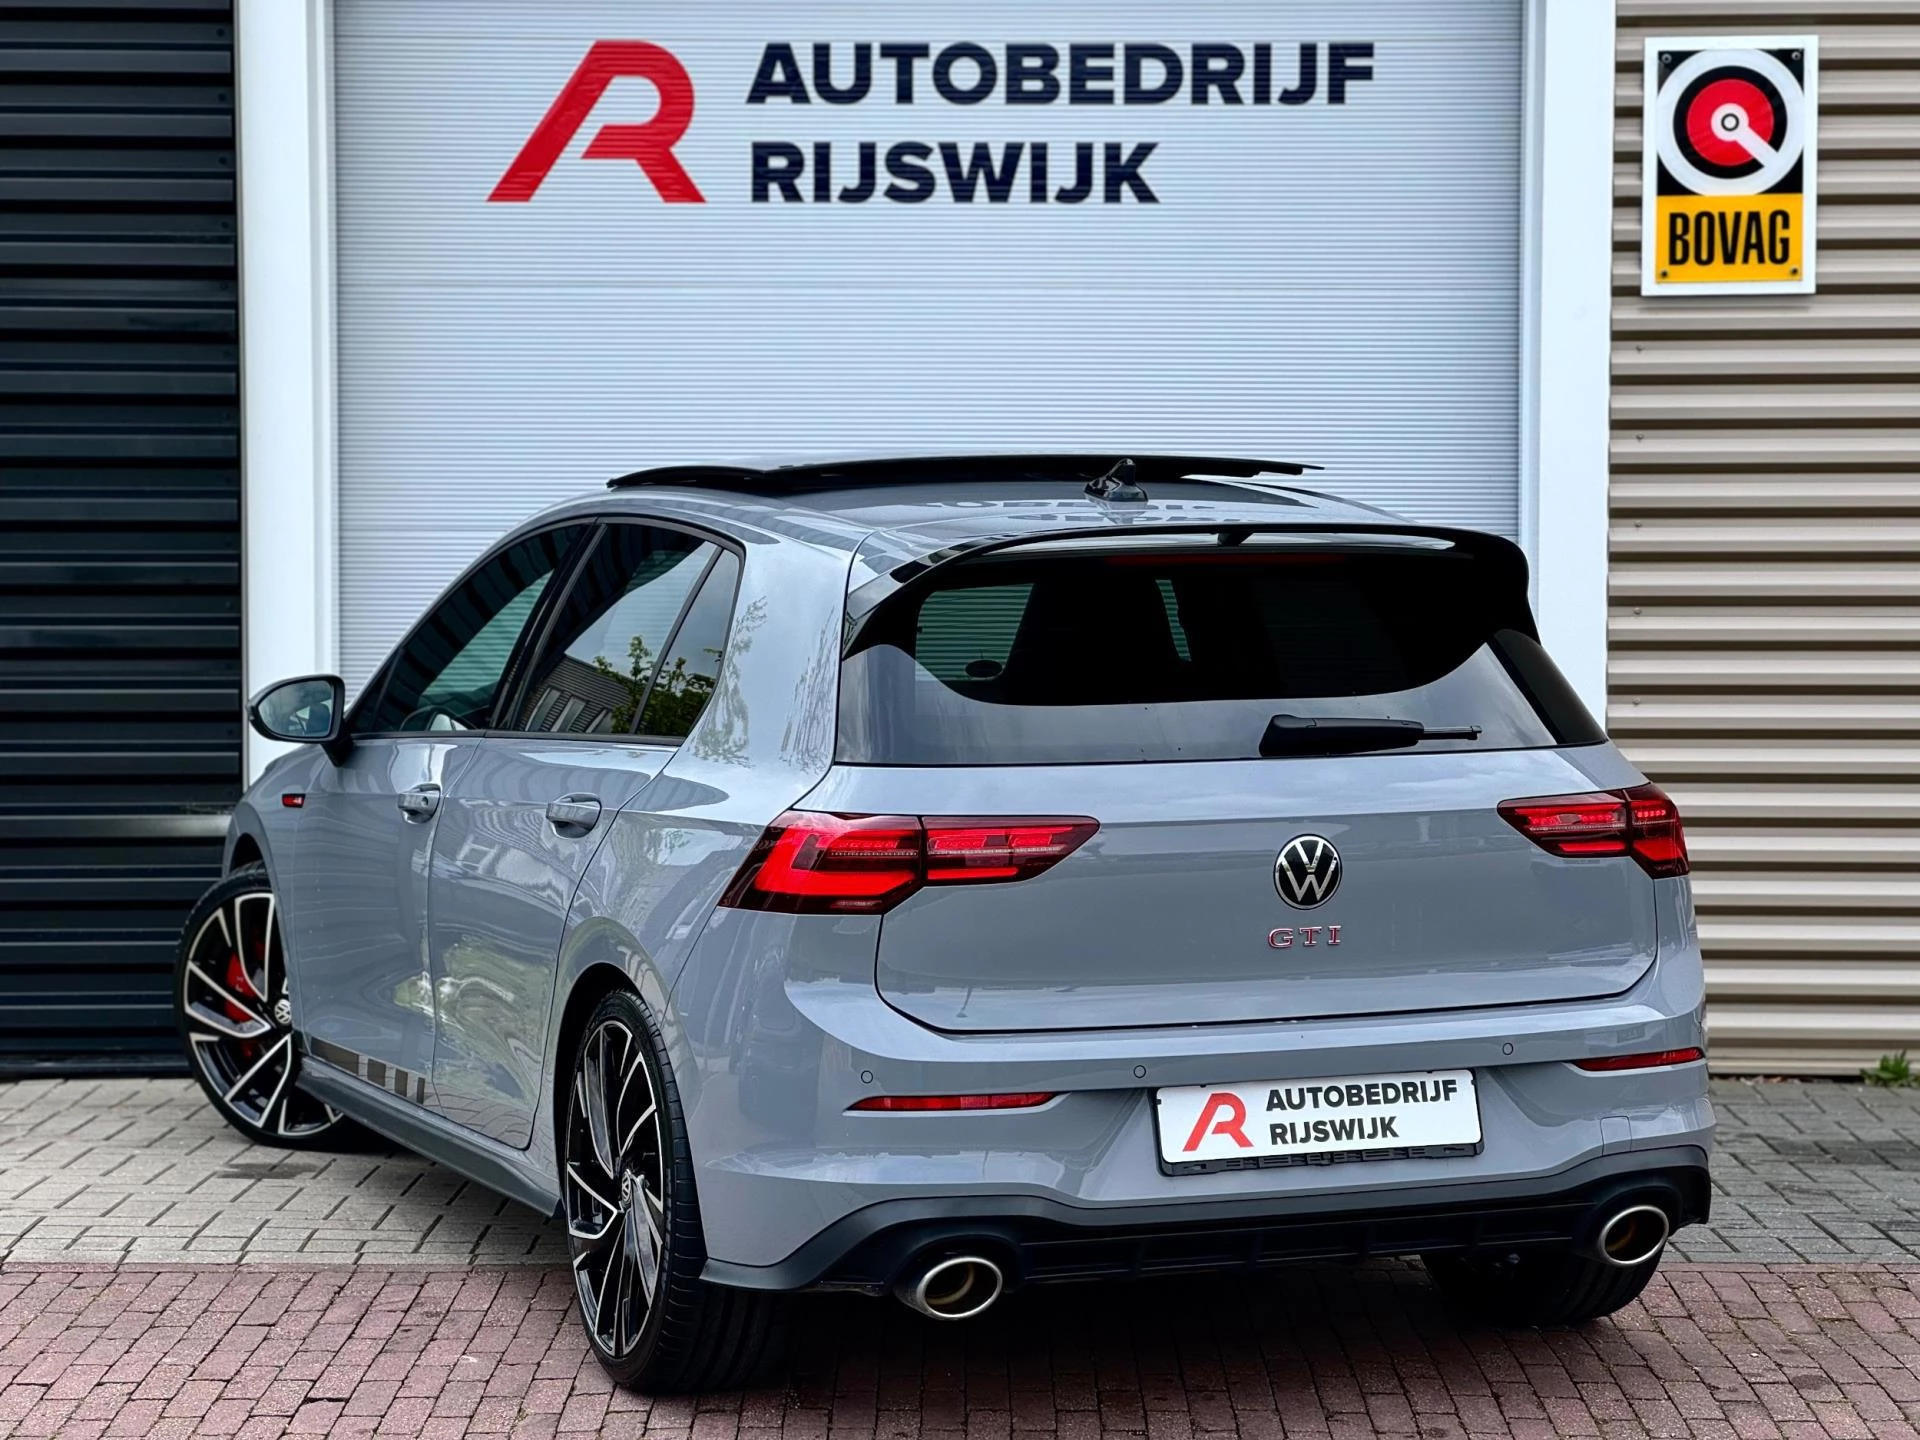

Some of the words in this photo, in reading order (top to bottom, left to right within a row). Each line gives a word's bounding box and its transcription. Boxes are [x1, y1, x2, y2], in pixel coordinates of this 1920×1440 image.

[746, 42, 1374, 105] AUTOBEDRIJF
[751, 142, 1159, 204] RIJSWIJK
[1668, 210, 1790, 266] BOVAG
[1268, 925, 1342, 948] GTI
[1265, 1079, 1457, 1111] AUTOBEDRIJF
[1269, 1116, 1399, 1145] RIJSWIJK
